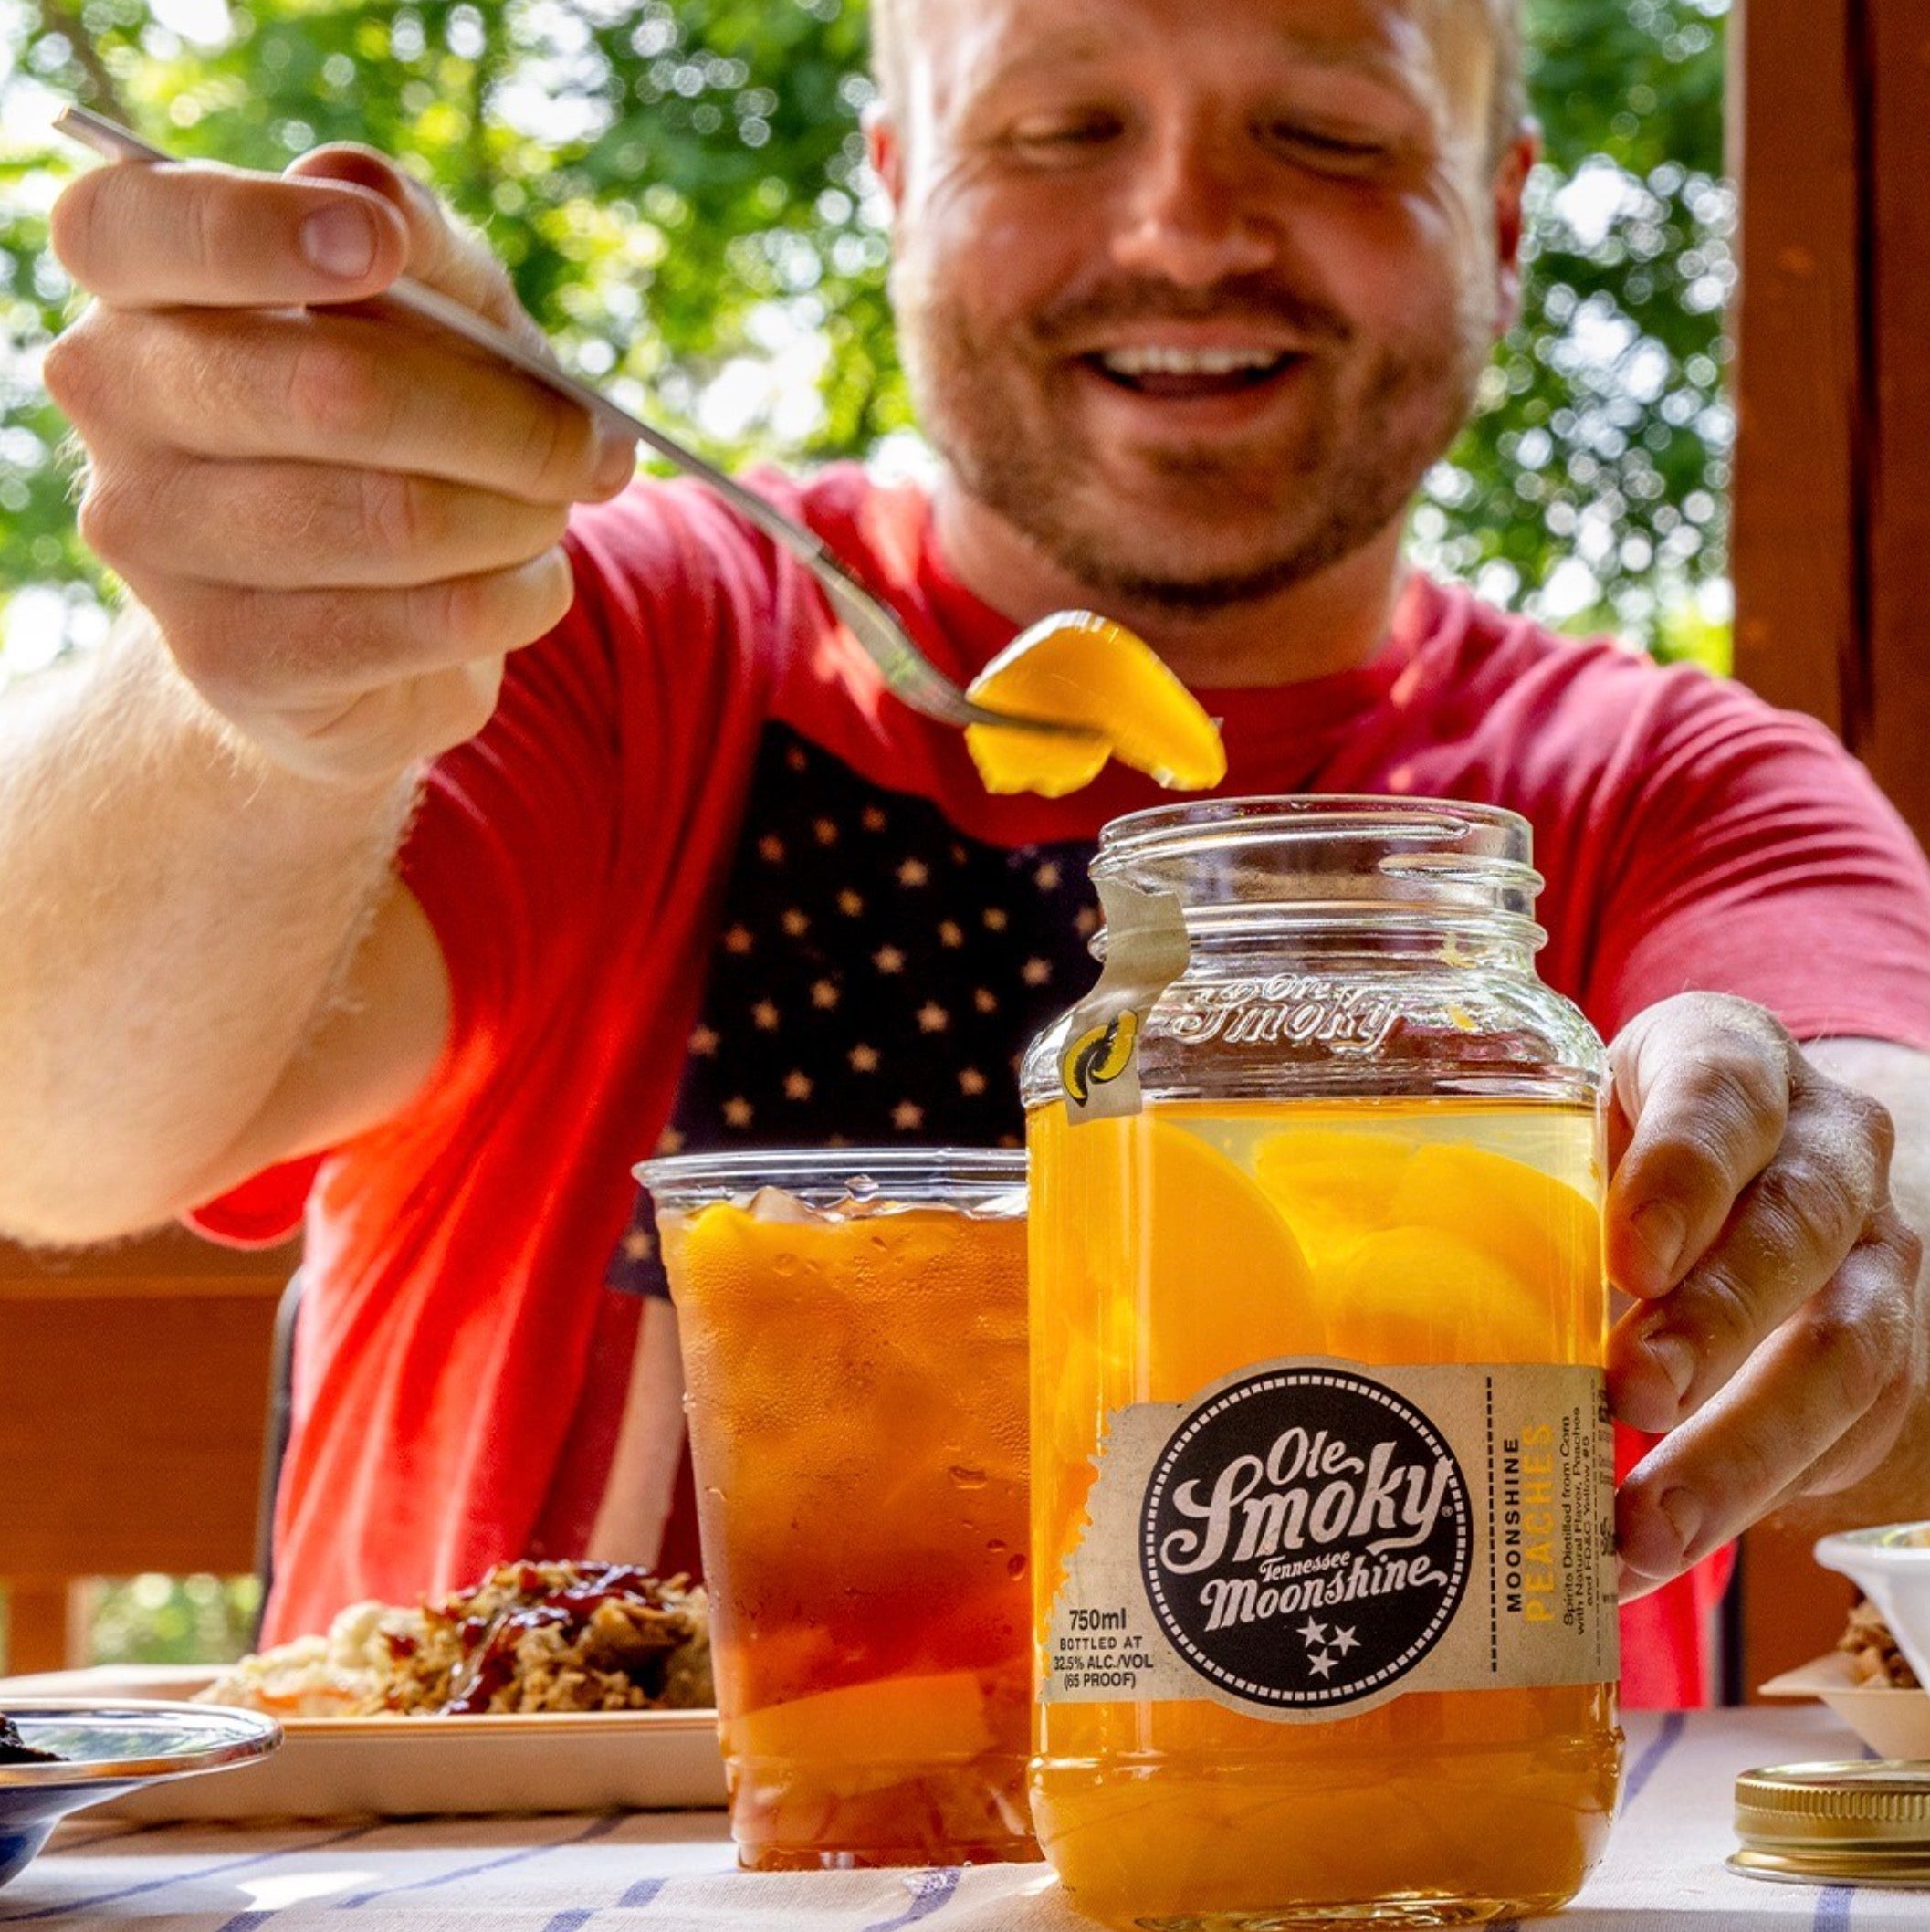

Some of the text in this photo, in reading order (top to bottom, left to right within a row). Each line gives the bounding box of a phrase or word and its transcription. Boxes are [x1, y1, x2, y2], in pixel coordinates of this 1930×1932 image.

[1172, 981, 1403, 1056] Smoky
[1266, 1427, 1365, 1486] Ole
[1572, 1406, 1581, 1476] Peaches
[1560, 1462, 1571, 1498] from
[1583, 1465, 1591, 1516] Yellow
[1160, 1441, 1454, 1575] Smoky
[1504, 1438, 1521, 1612] MOONSHINE
[1522, 1423, 1554, 1622] PEACHES
[1561, 1504, 1573, 1568] Distilled
[1200, 1554, 1448, 1632] Moonshine
[1258, 1551, 1350, 1583] Tennessee
[1574, 1538, 1584, 1595] Natural
[1584, 1576, 1593, 1606] and
[1069, 1607, 1127, 1631] 750ml
[1563, 1573, 1576, 1626] Spirits
[1574, 1601, 1586, 1636] with
[1054, 1654, 1154, 1670] 32.5% ALC./VOL
[1059, 1635, 1143, 1651] BOTTLED AT
[1064, 1672, 1136, 1691] (65 PROOF)
